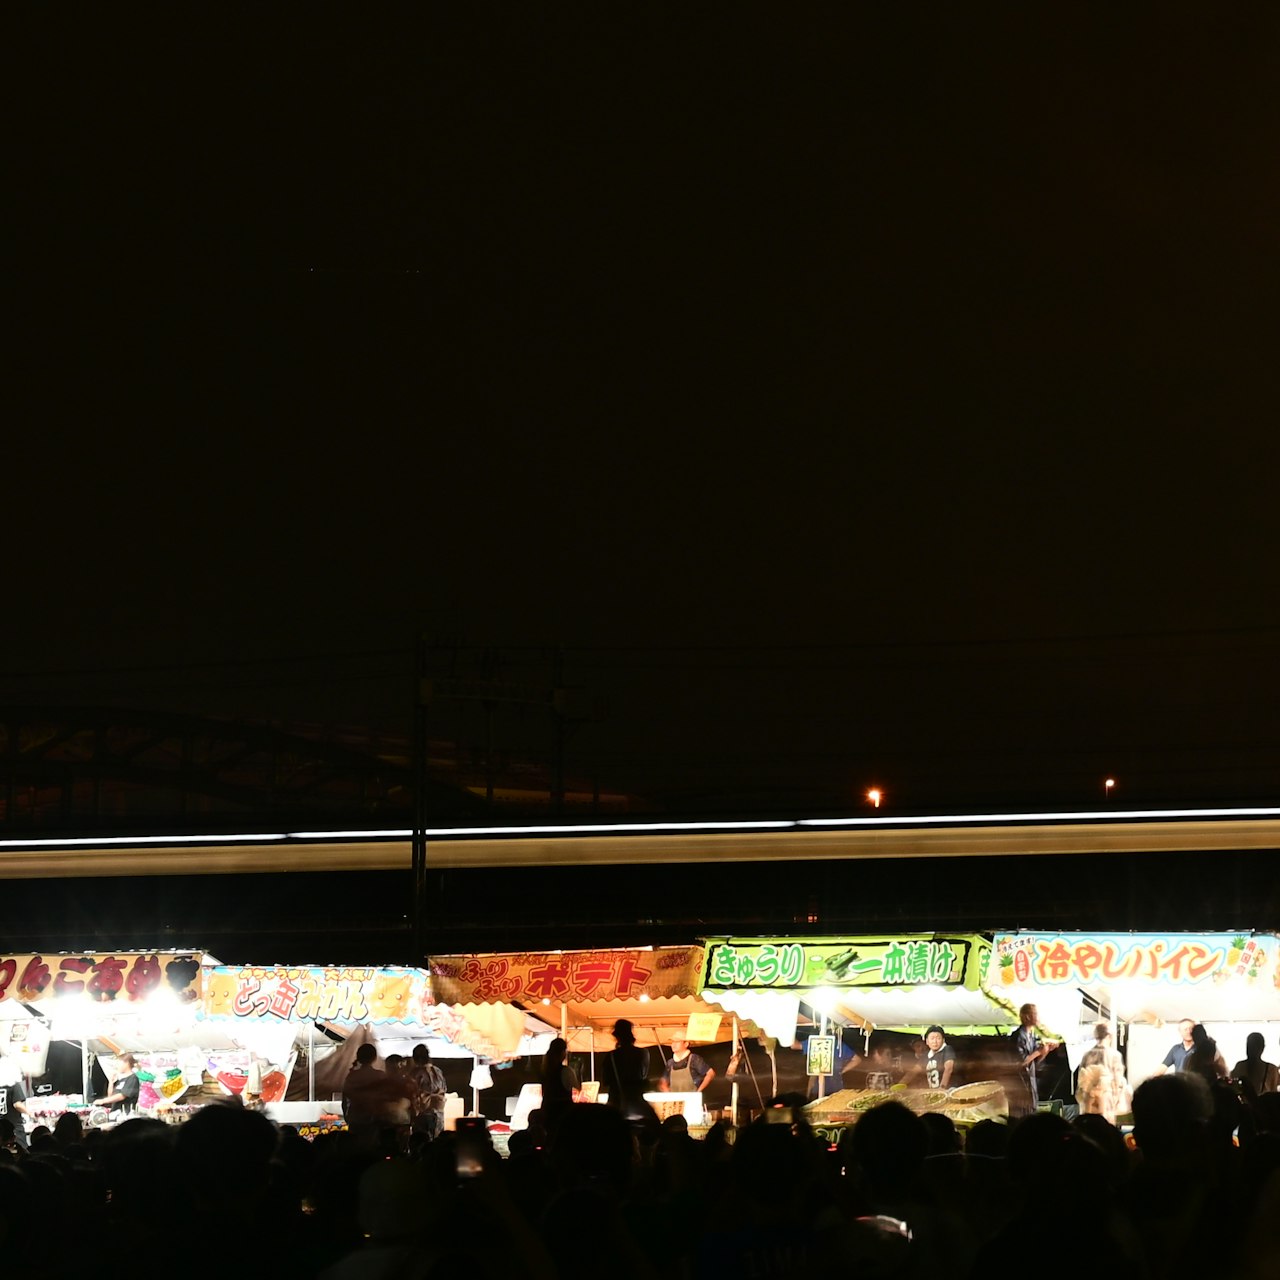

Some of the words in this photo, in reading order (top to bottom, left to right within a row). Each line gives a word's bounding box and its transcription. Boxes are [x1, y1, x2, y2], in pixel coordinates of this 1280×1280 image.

[524, 958, 652, 998] ポテト
[714, 942, 806, 985] きゅうり
[852, 940, 955, 983] 一本漬け
[1037, 940, 1222, 980] 冷やしパイン
